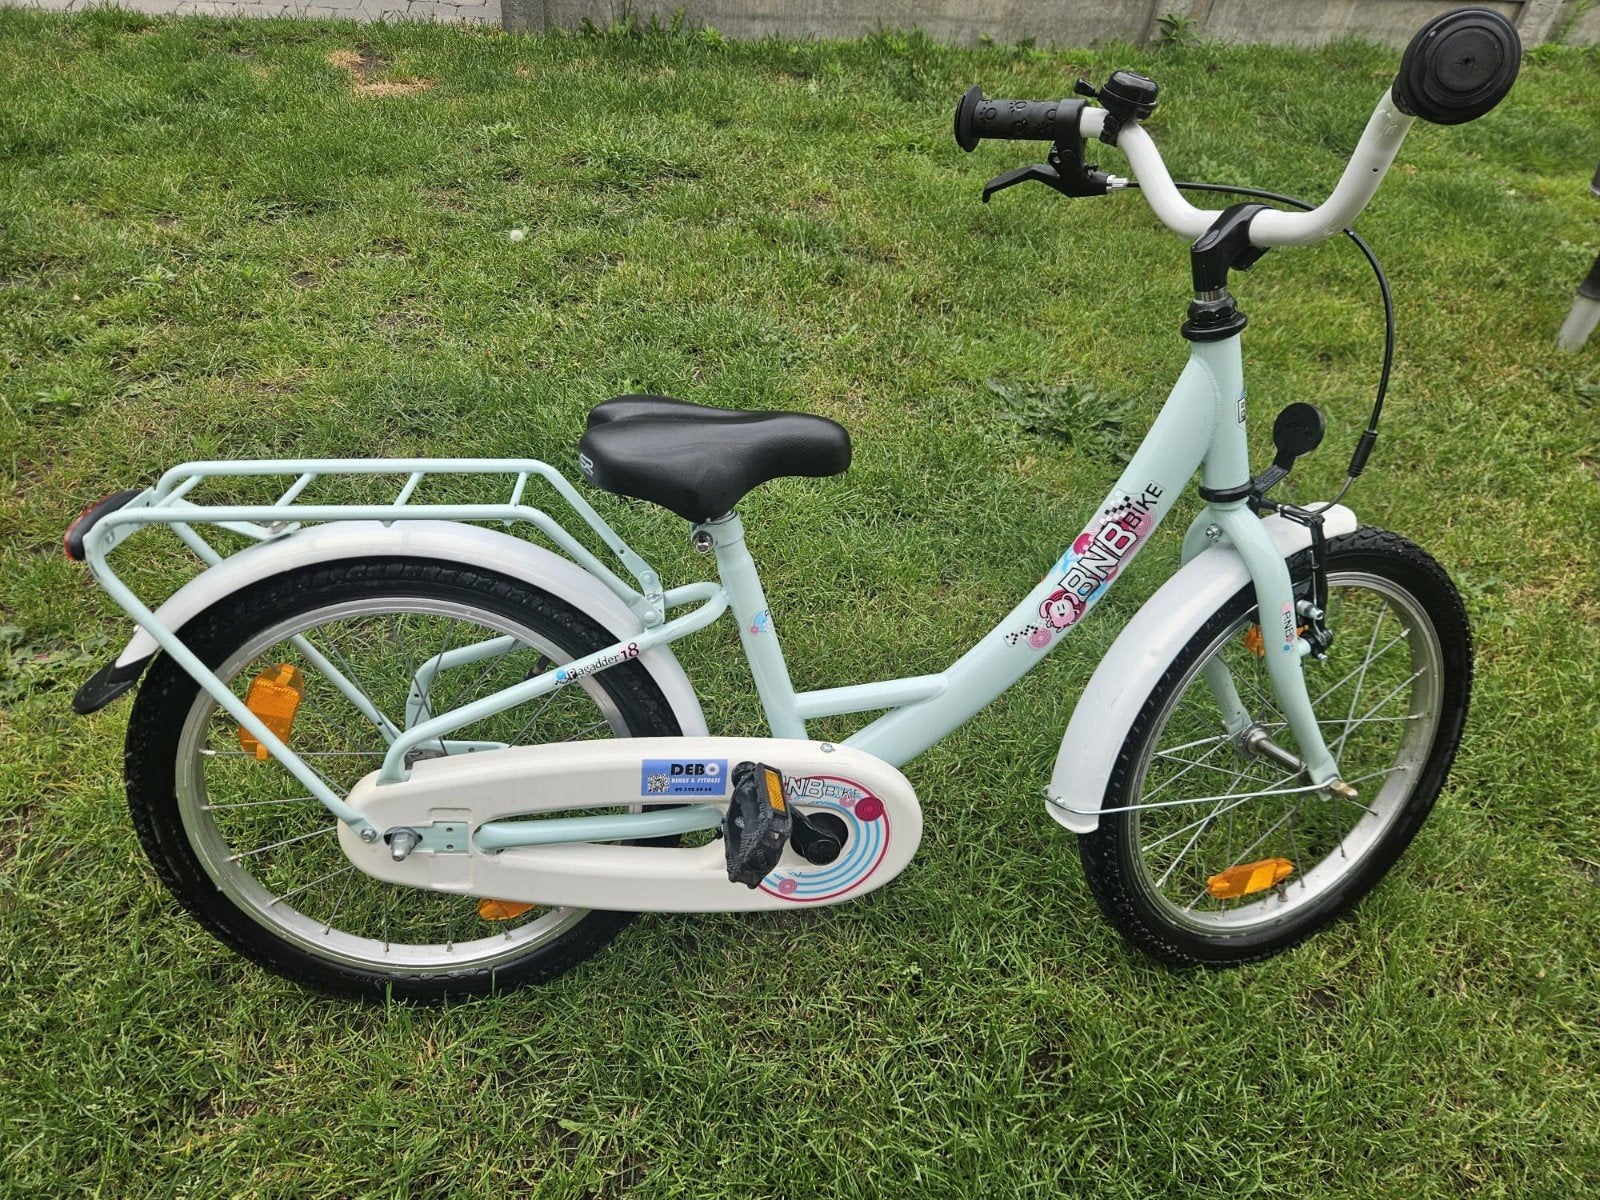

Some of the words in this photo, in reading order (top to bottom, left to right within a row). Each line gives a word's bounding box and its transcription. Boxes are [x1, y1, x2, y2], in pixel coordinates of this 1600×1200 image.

[1058, 521, 1138, 603] BNB
[1122, 483, 1163, 529] BIKE
[620, 642, 640, 660] 18
[671, 763, 720, 776] DEBO
[782, 775, 825, 799] NB
